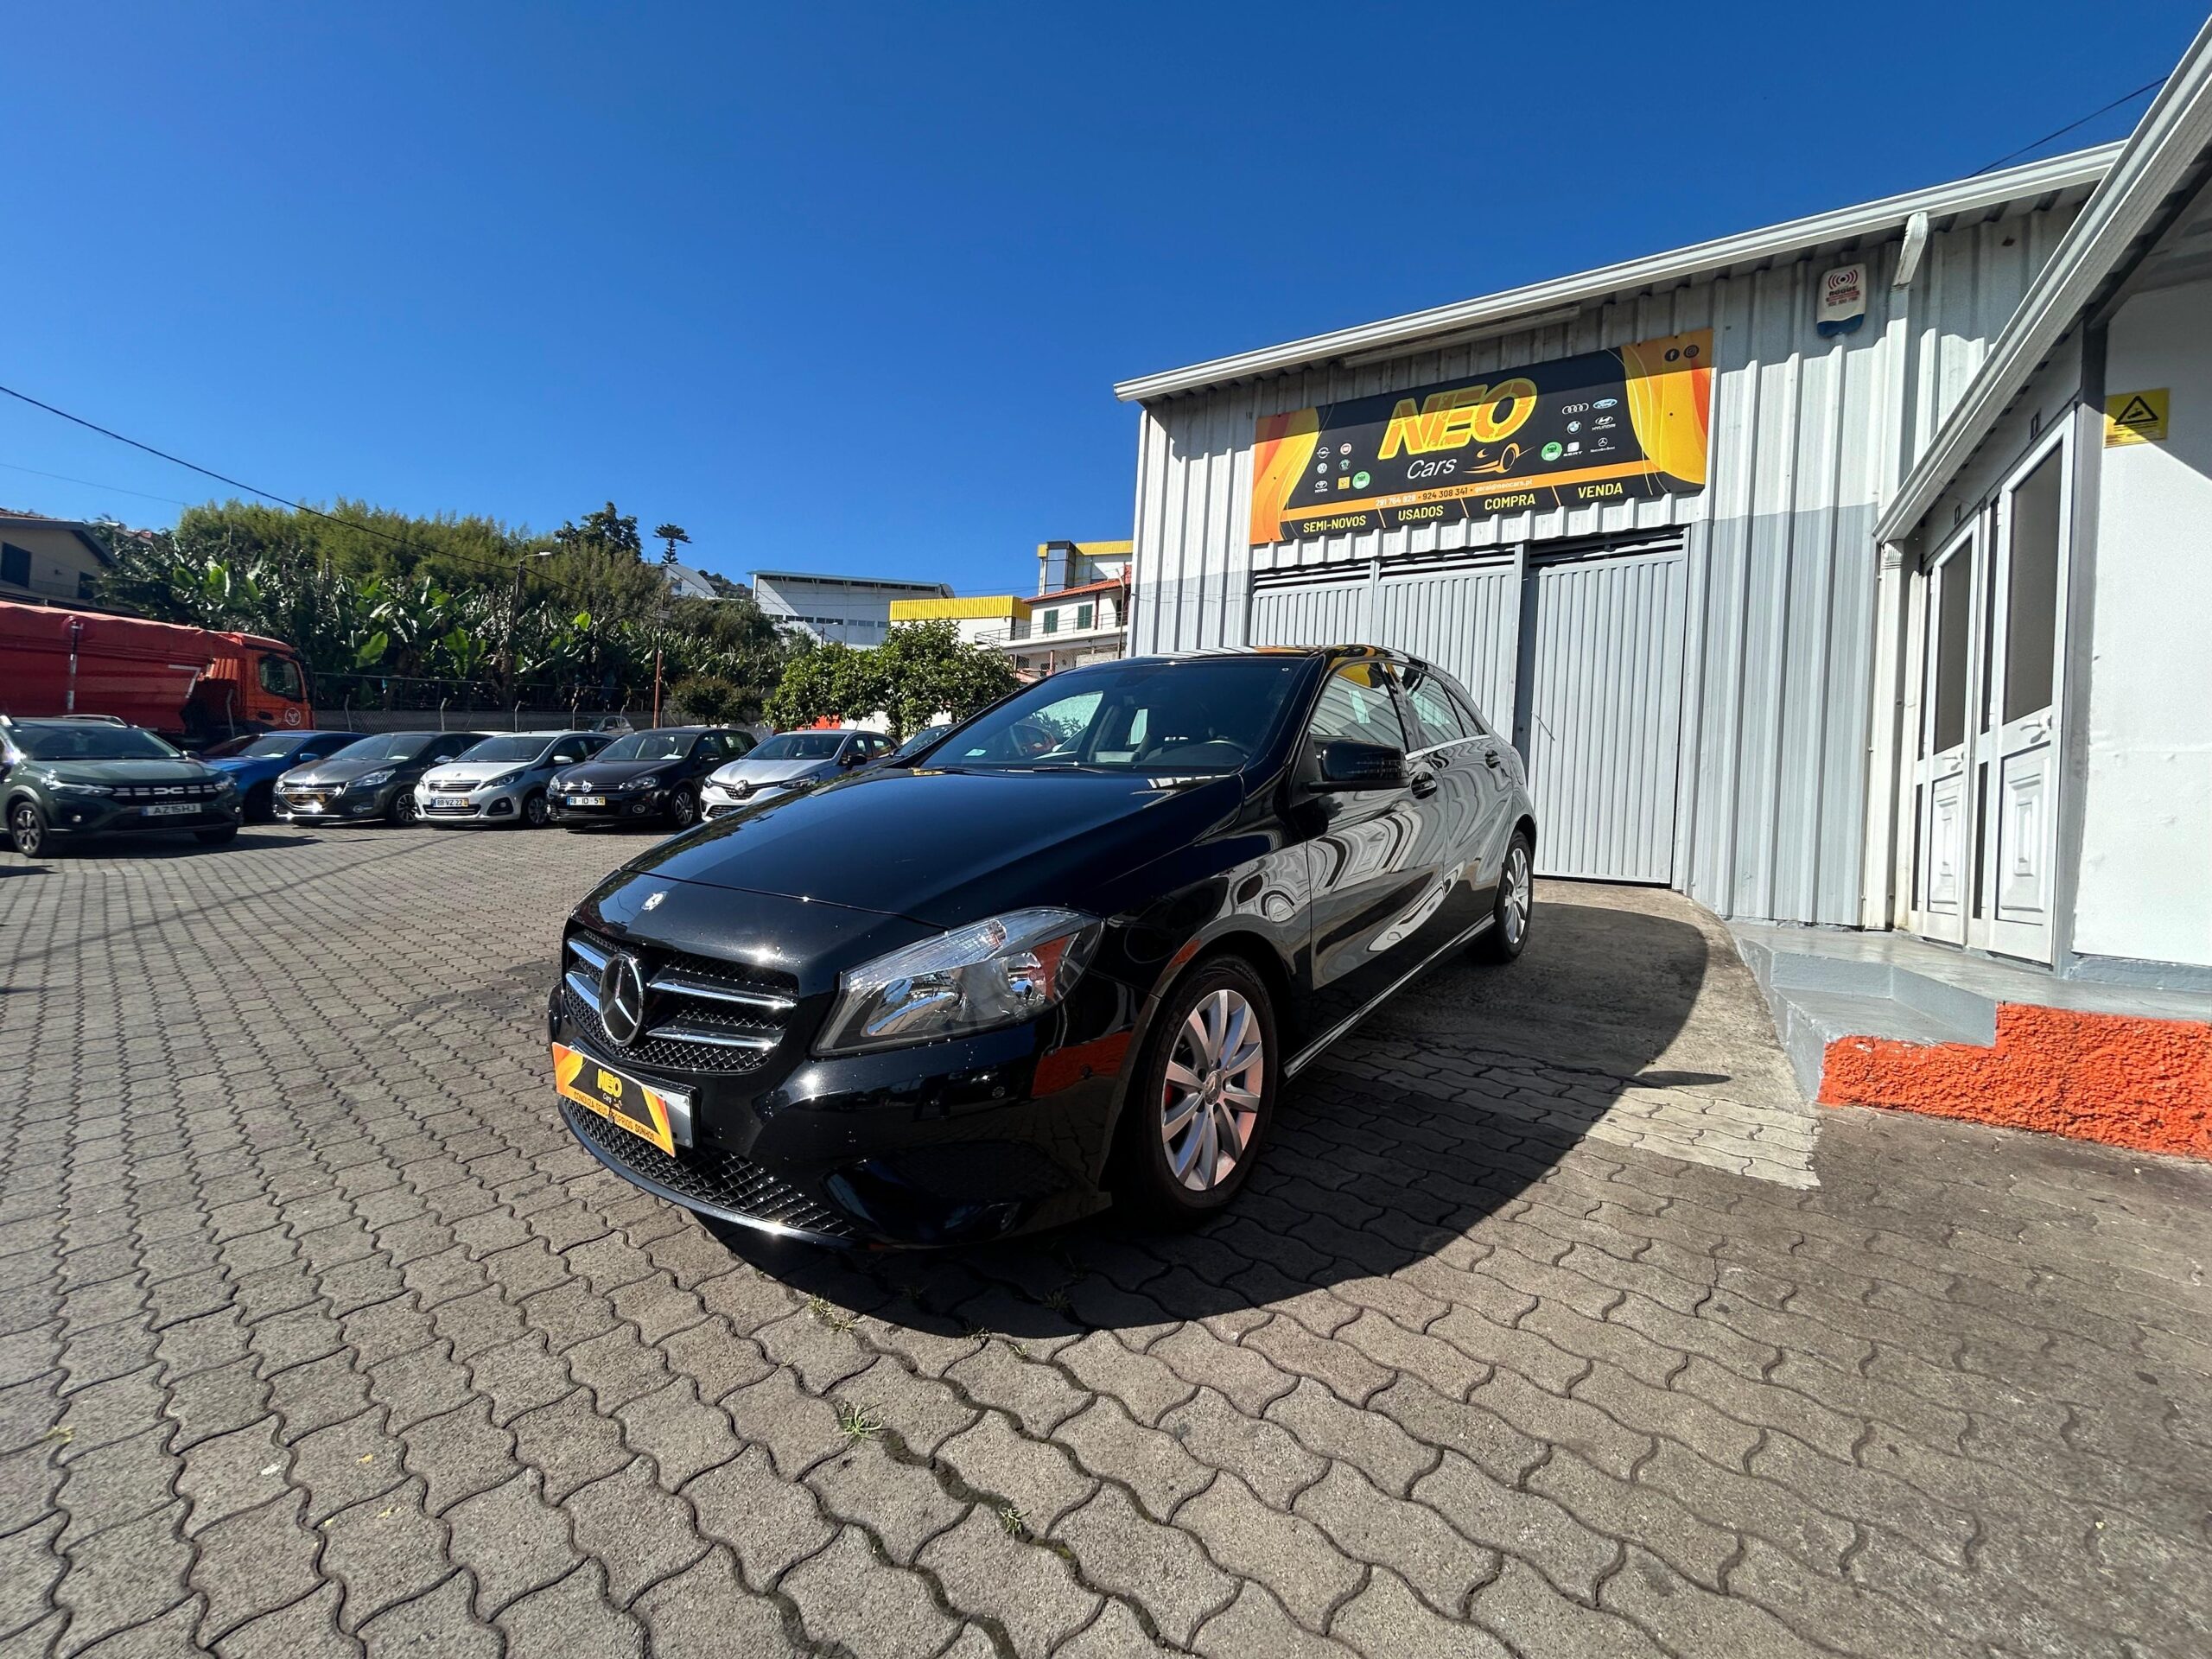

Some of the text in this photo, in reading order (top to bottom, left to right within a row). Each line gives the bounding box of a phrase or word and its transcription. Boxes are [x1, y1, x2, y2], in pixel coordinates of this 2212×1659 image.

[1377, 378, 1537, 460] NEO
[1407, 459, 1457, 480] Cars
[1422, 492, 1436, 500] 924
[1439, 490, 1452, 499] 308
[1455, 487, 1468, 496] 341
[1578, 482, 1623, 499] VENDA
[1484, 493, 1535, 510] COMPRA
[1398, 505, 1444, 521] USADOS
[1303, 515, 1366, 533] SEMI-NOVOS
[597, 1068, 622, 1097] NEO
